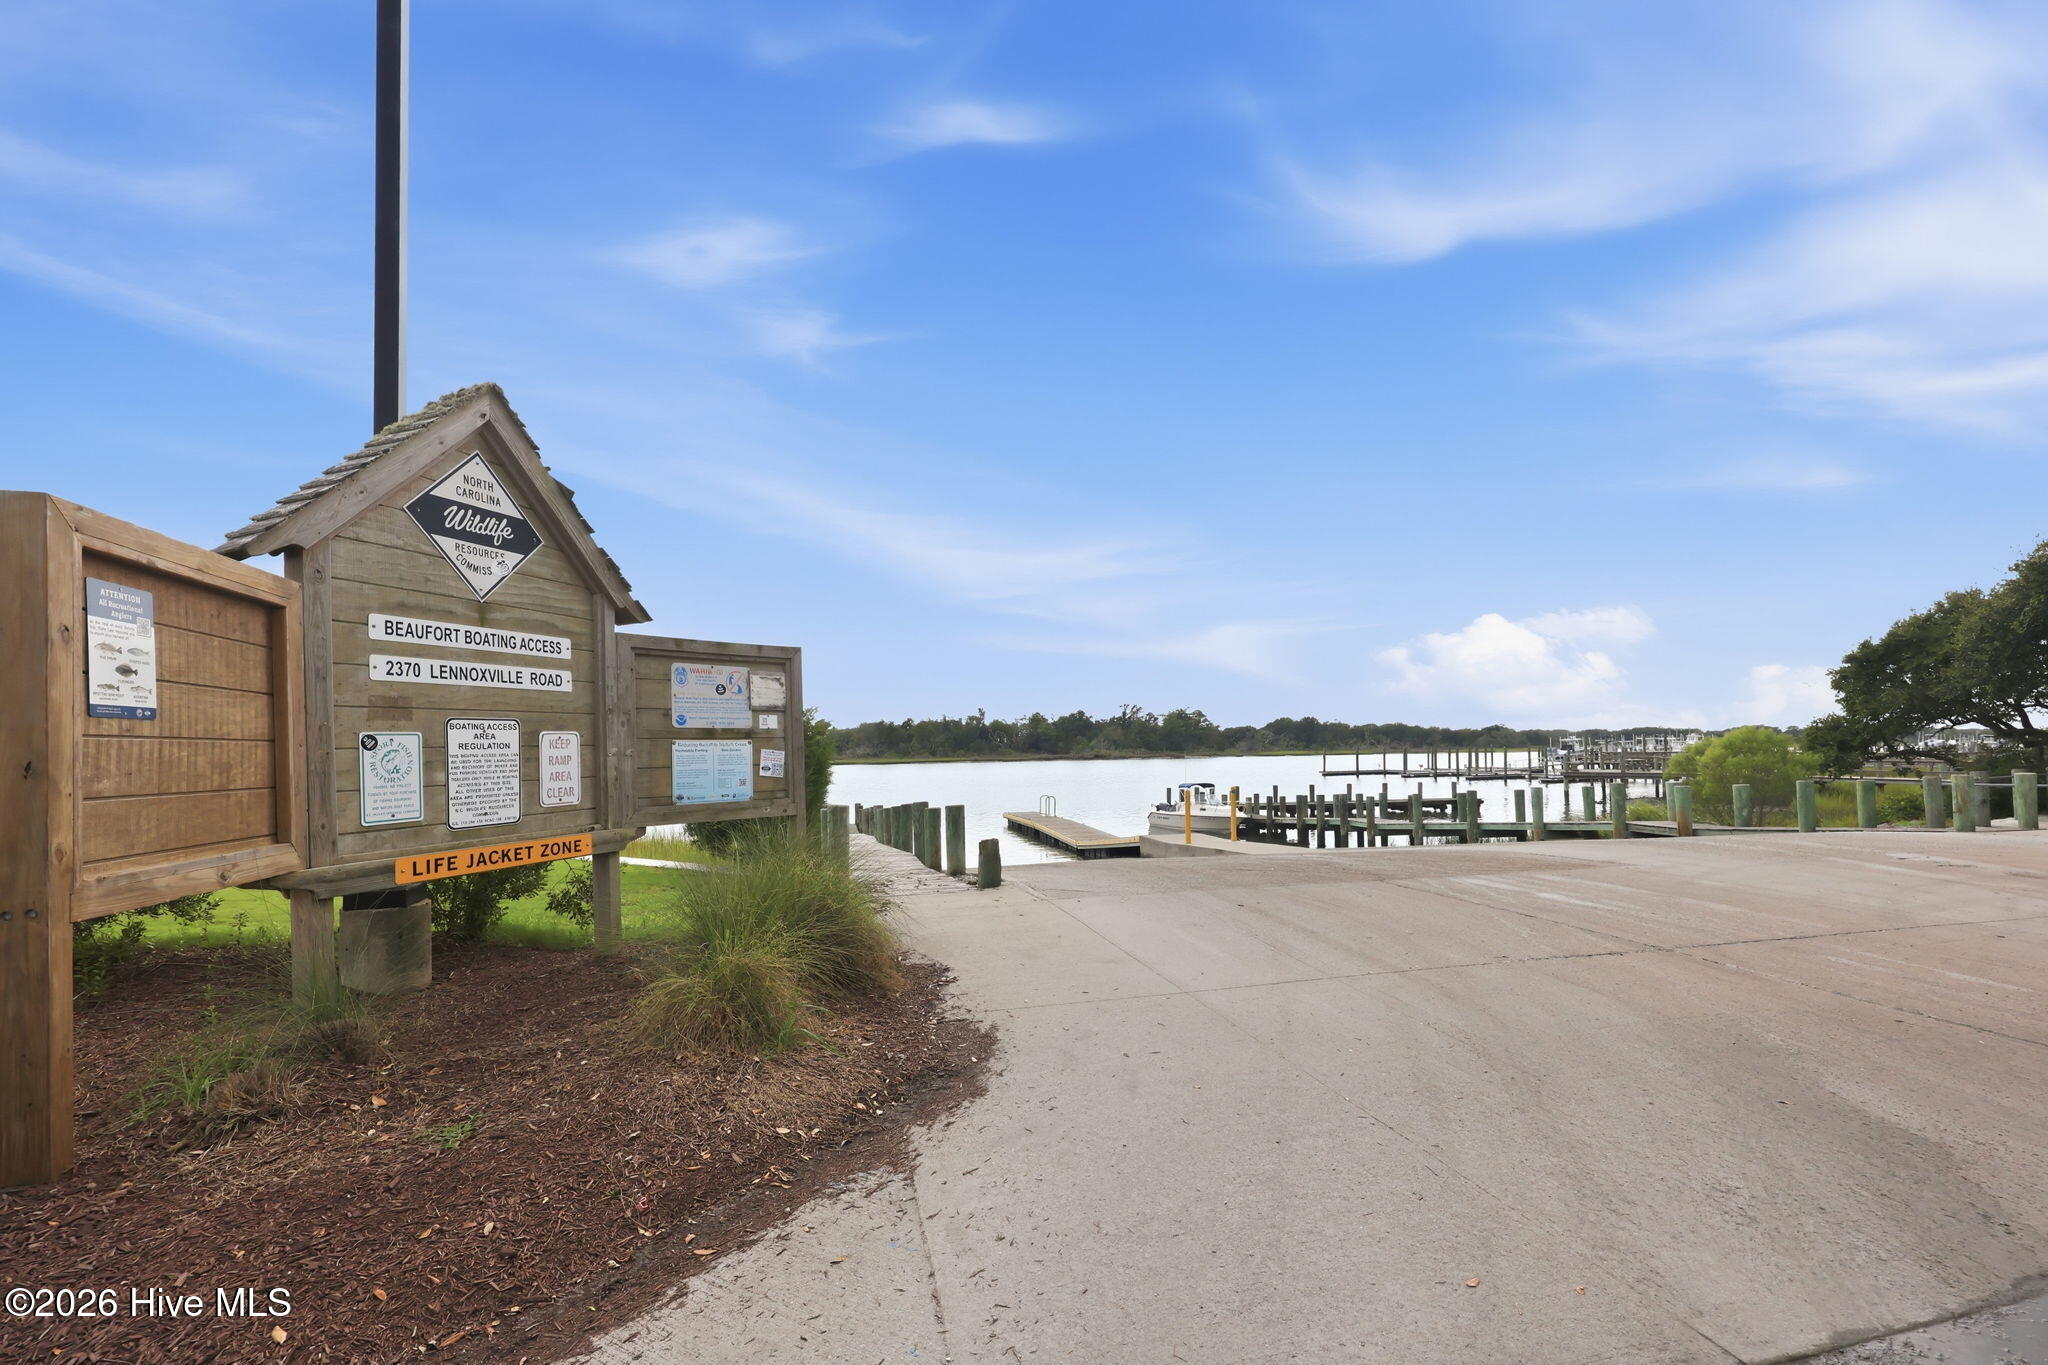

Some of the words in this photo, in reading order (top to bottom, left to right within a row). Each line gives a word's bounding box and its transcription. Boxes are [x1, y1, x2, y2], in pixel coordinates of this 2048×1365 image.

[463, 474, 494, 492] NORTH
[456, 486, 502, 507] CAROLINA
[444, 506, 514, 546] Wildlife
[456, 554, 492, 576] COMMISS
[100, 588, 140, 604] ATTENTION
[99, 598, 108, 606] All
[108, 600, 143, 614] Recreational
[111, 610, 132, 620] Anglers
[384, 620, 460, 643] BEAUFORT
[464, 630, 517, 650] BOATING
[520, 638, 562, 655] ACCESS
[386, 660, 421, 678] 2370
[430, 664, 524, 684] LENNOXVILLE
[530, 672, 563, 687] ROAD
[370, 740, 394, 760] SPORT
[398, 742, 414, 758] FISH
[549, 738, 571, 749] KEEP
[548, 755, 572, 766] RAMP
[370, 760, 414, 784] RESTORATION
[550, 771, 572, 782] AREA
[547, 786, 574, 798] CLEAR
[412, 856, 458, 876] LIFE
[466, 846, 534, 869] JACKET
[540, 839, 582, 857] ZONE
